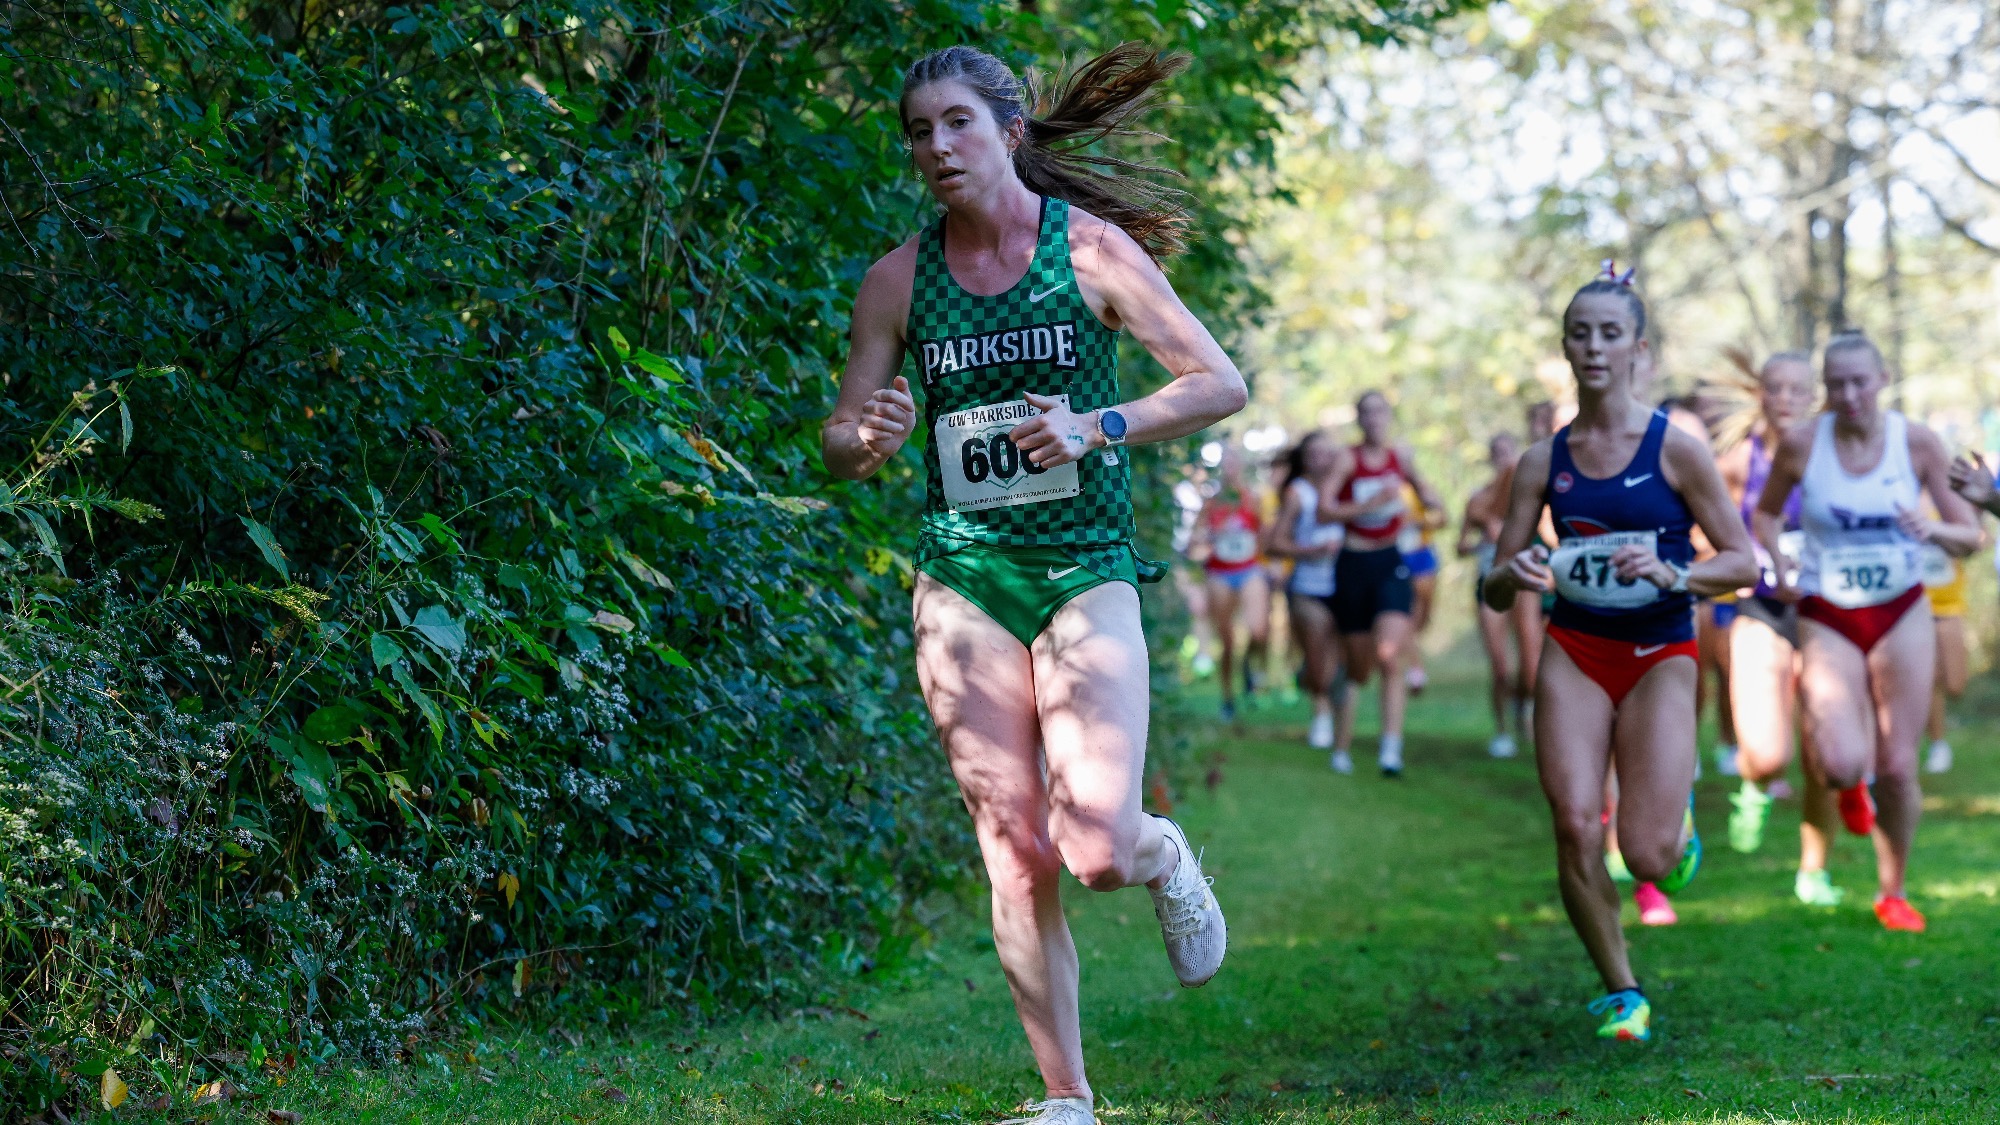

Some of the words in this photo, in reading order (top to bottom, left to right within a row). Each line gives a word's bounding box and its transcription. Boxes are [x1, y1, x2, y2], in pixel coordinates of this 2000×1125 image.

[923, 323, 1077, 385] PARKSIDE
[948, 403, 1036, 428] UW-PARKSIDE
[1838, 564, 1891, 591] 302
